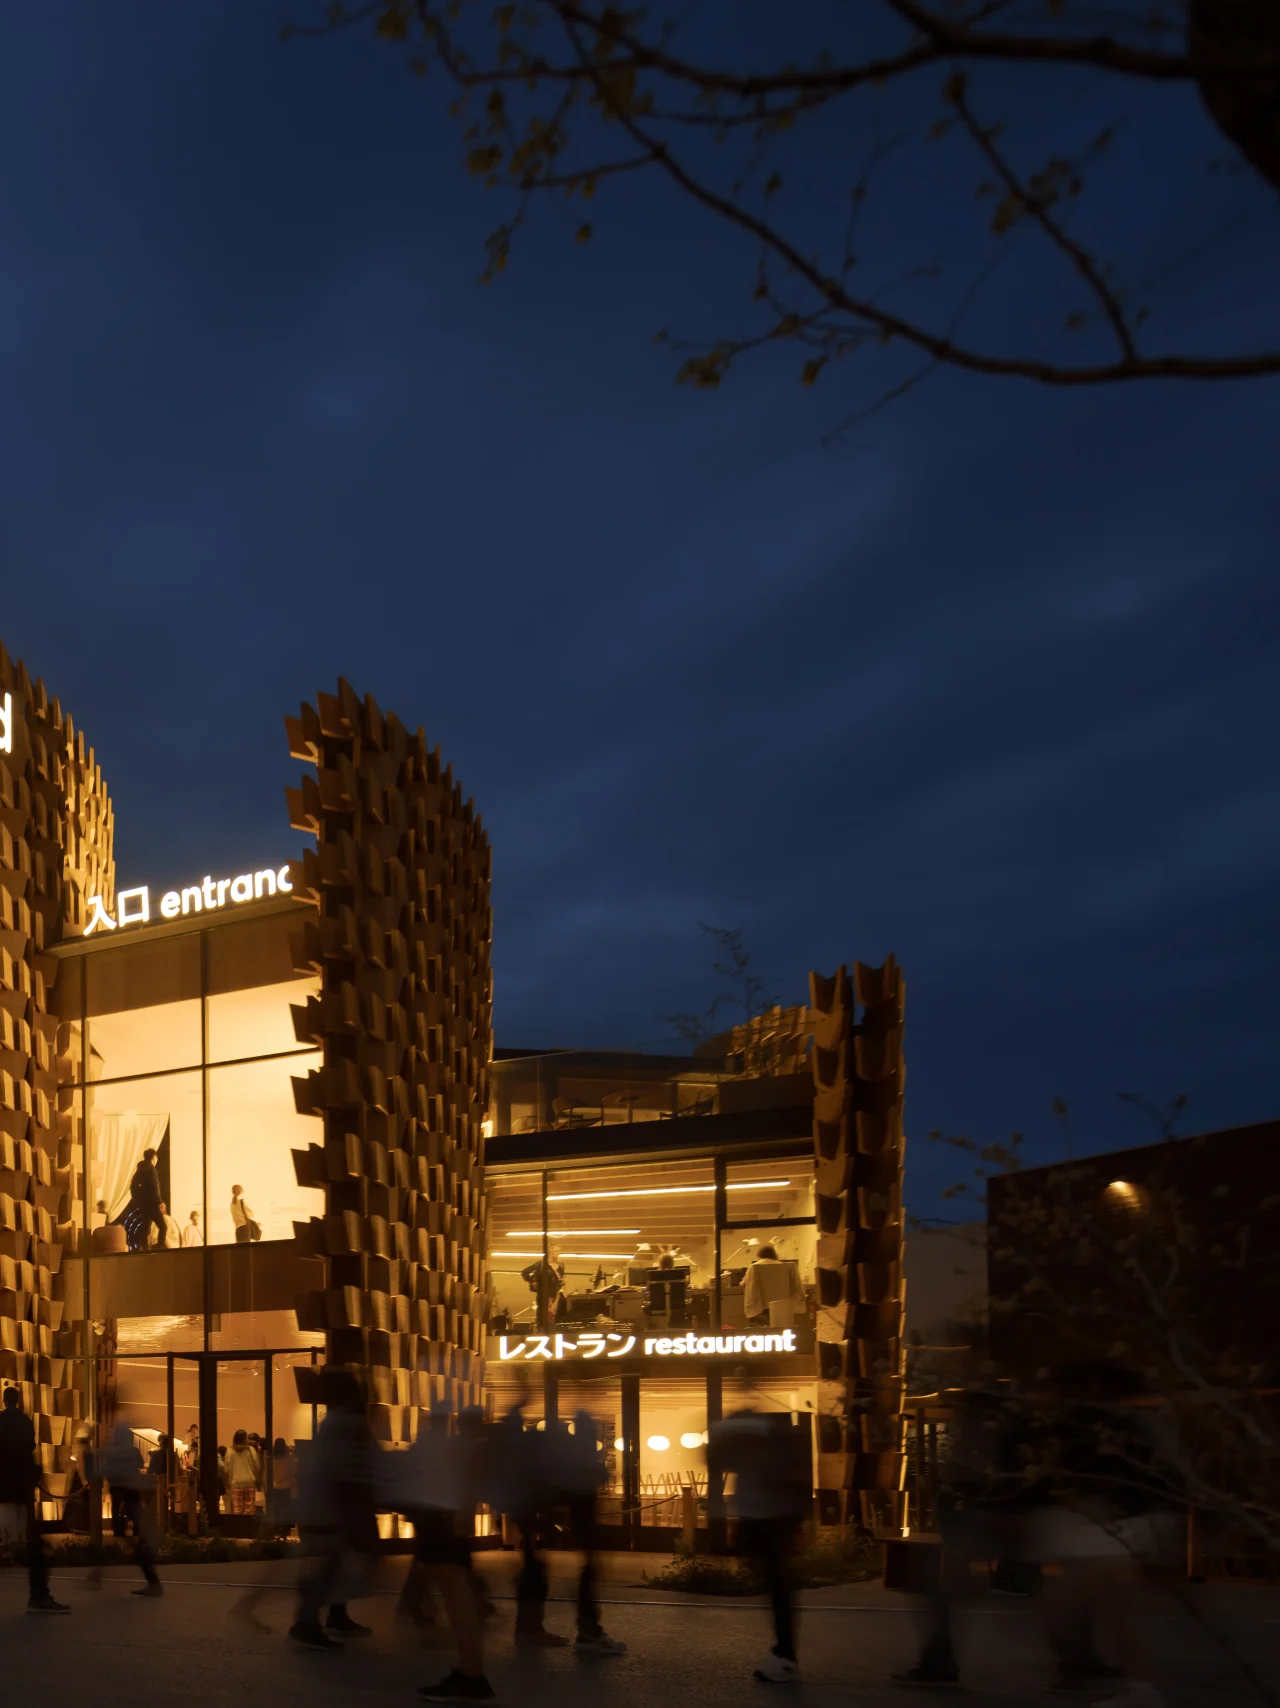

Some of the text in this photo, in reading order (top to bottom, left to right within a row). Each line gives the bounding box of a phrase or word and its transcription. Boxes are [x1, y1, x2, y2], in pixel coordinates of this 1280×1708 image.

[83, 864, 293, 936] 入口 entranc
[499, 1329, 797, 1360] レストラン restaurant
